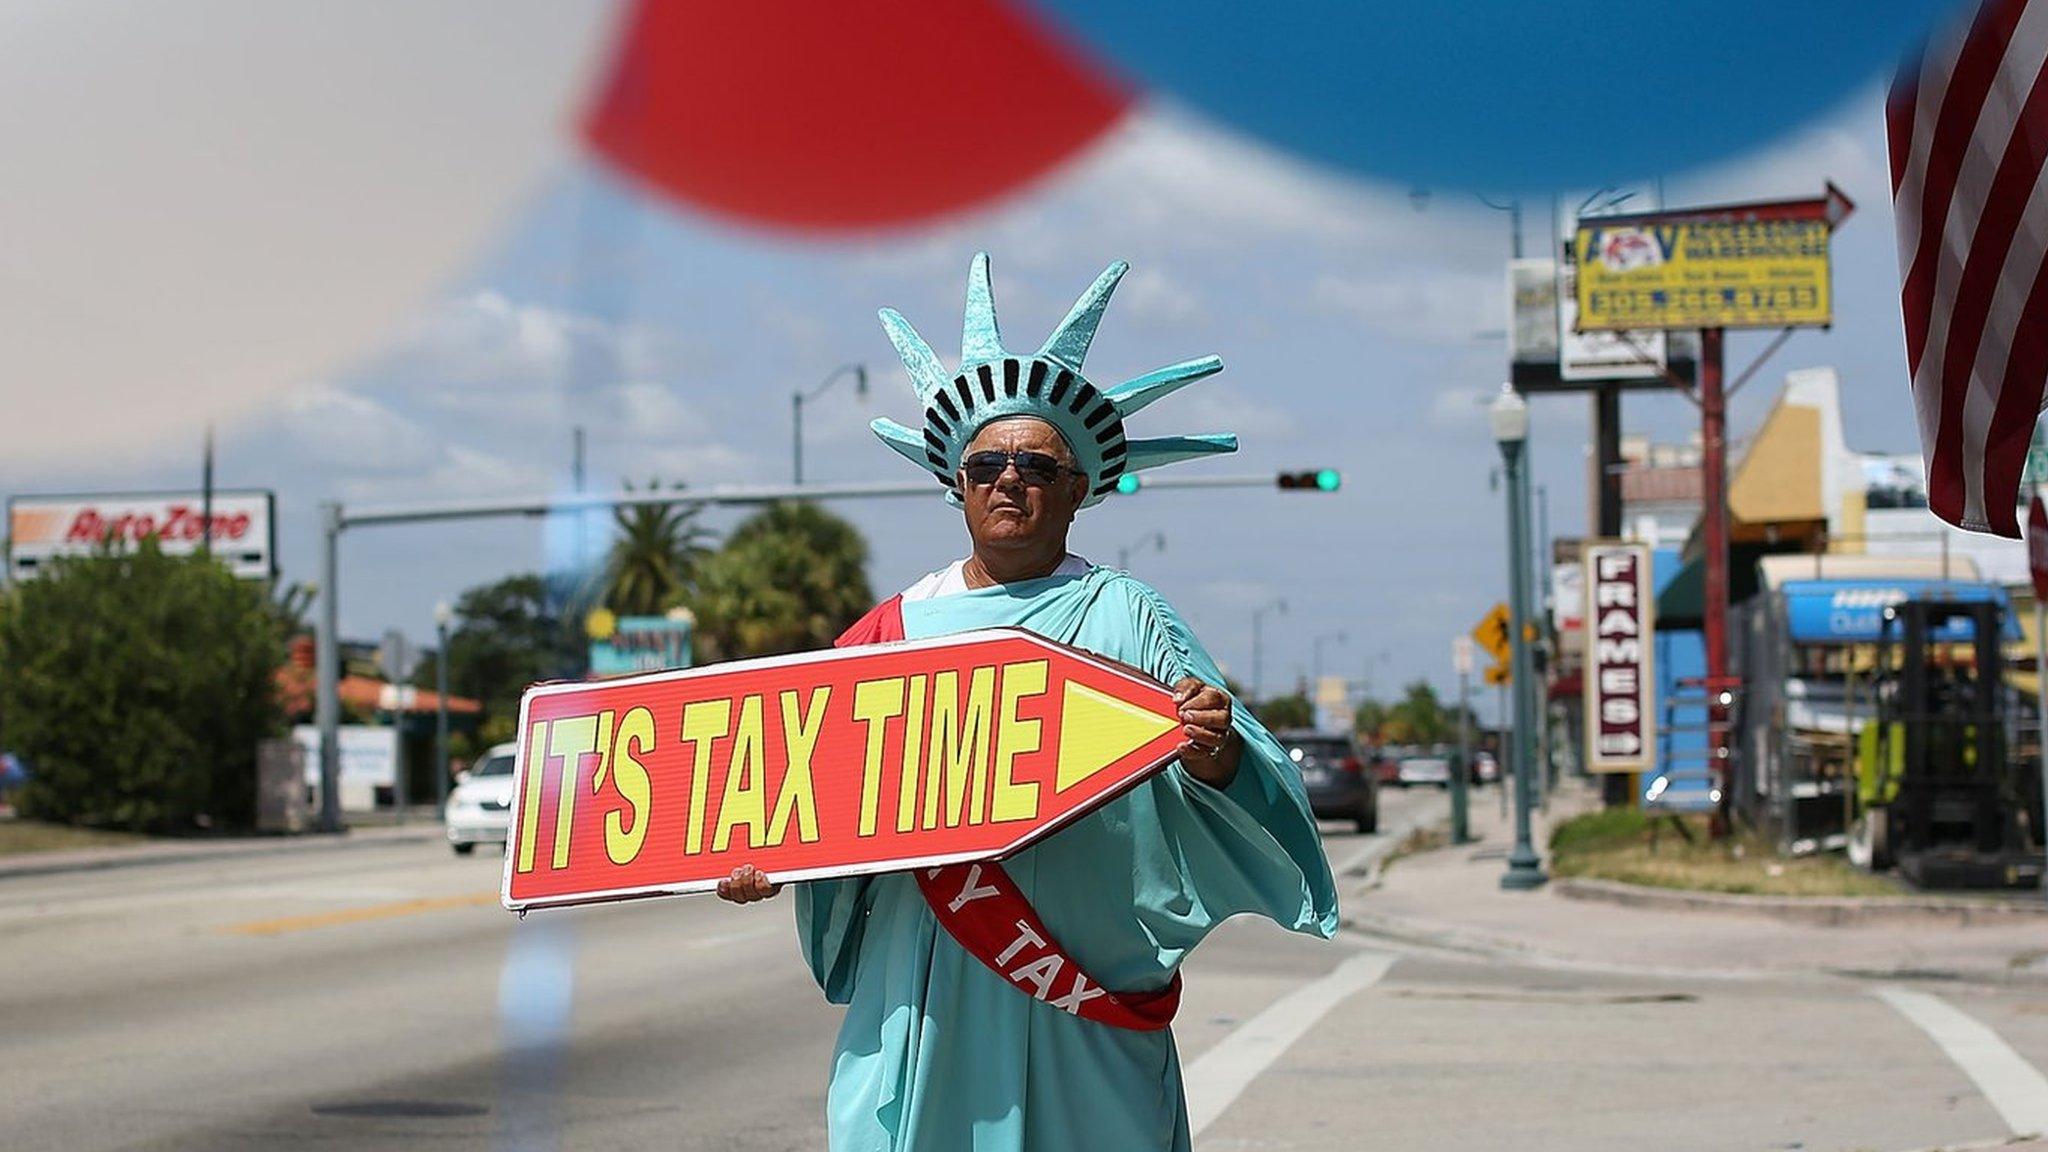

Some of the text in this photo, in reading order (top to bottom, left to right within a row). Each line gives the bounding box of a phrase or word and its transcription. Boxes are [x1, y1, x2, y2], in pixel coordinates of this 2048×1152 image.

[1685, 240, 1827, 258] WAREHOUSE
[66, 507, 249, 544] AutoZone
[1599, 556, 1639, 725] FRAMES
[517, 657, 1049, 873] IT'S TAX TIME
[995, 919, 1106, 1015] TAX
